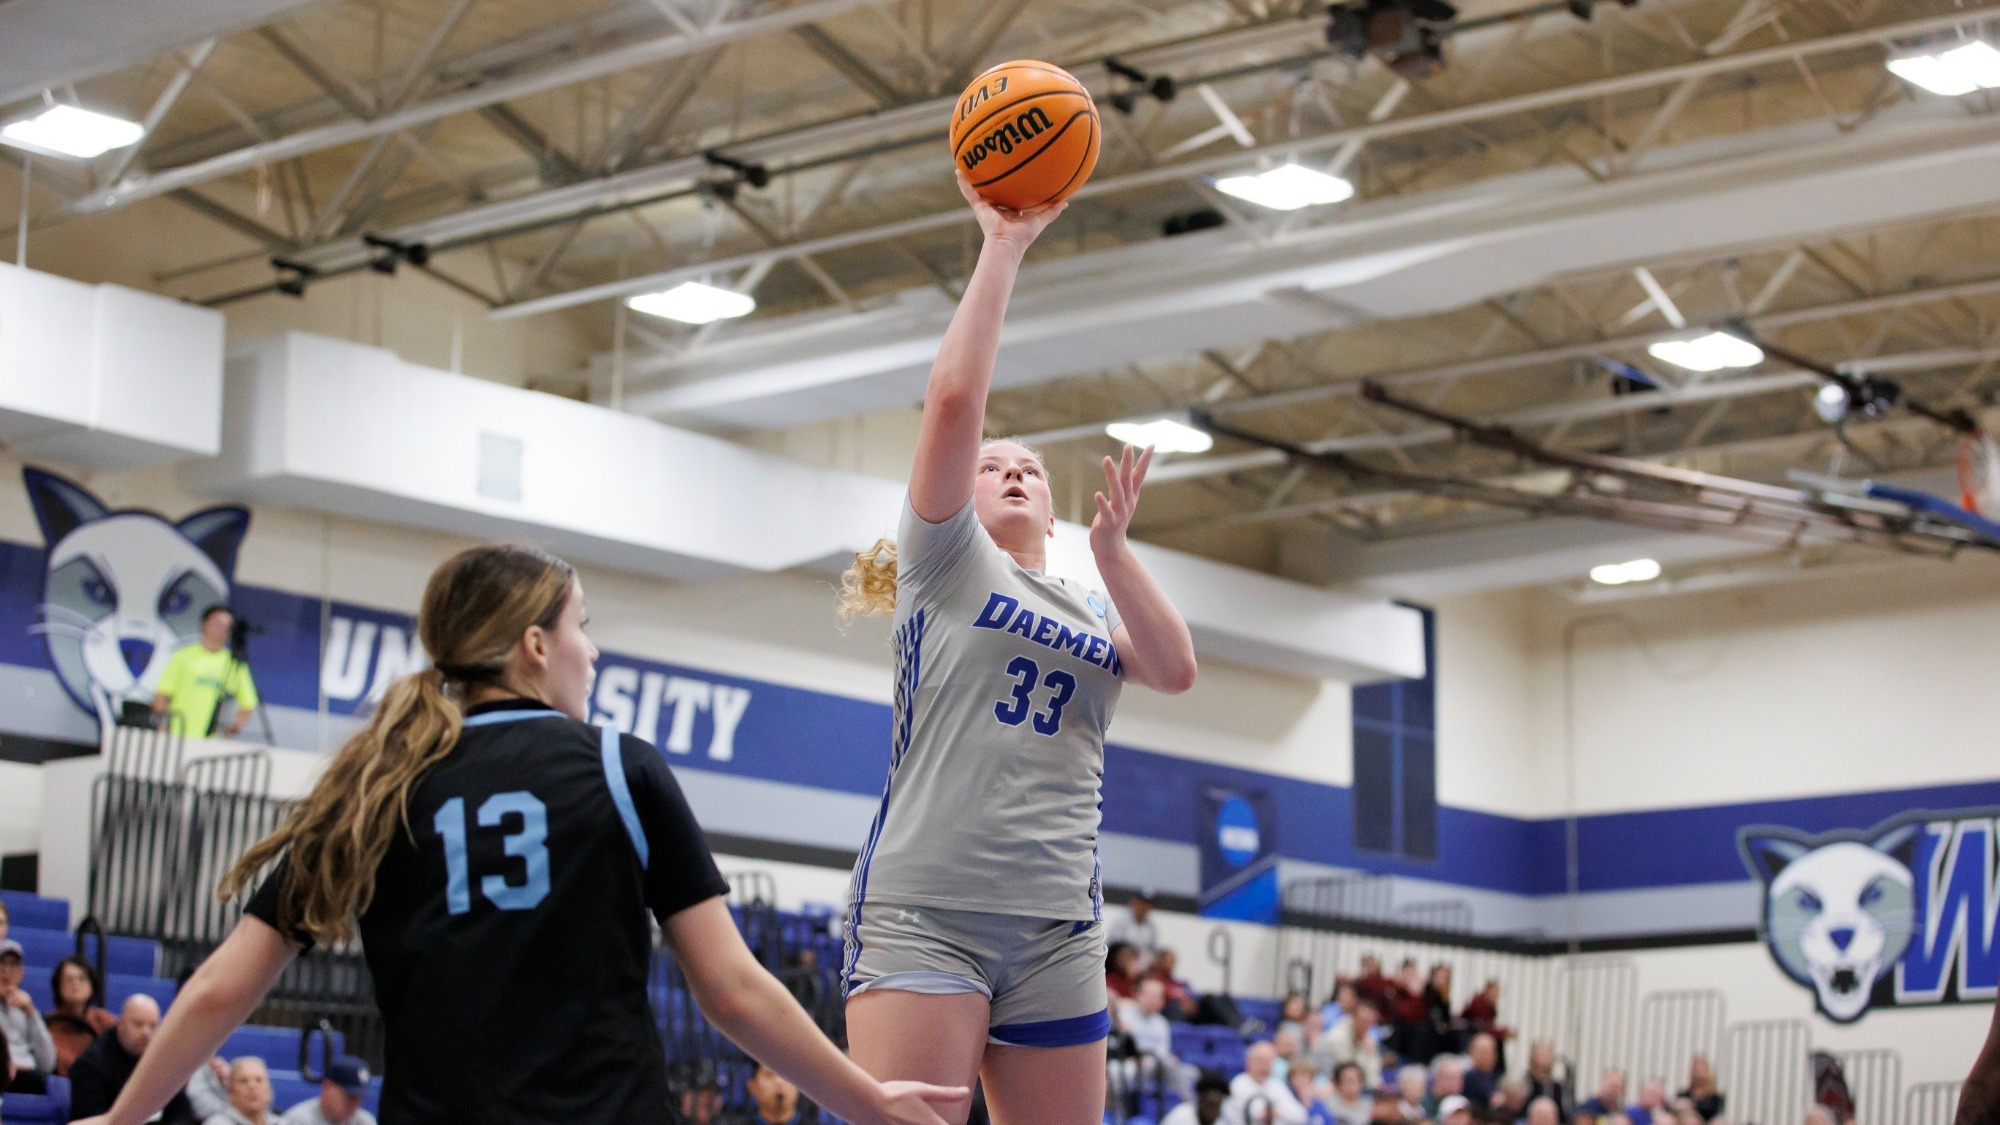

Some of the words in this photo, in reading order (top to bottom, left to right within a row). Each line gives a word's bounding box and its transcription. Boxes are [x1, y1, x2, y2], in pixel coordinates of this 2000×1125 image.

[961, 106, 1054, 170] Wilson
[971, 591, 1121, 678] DAEMEN
[993, 654, 1077, 737] 33
[433, 789, 551, 916] 13
